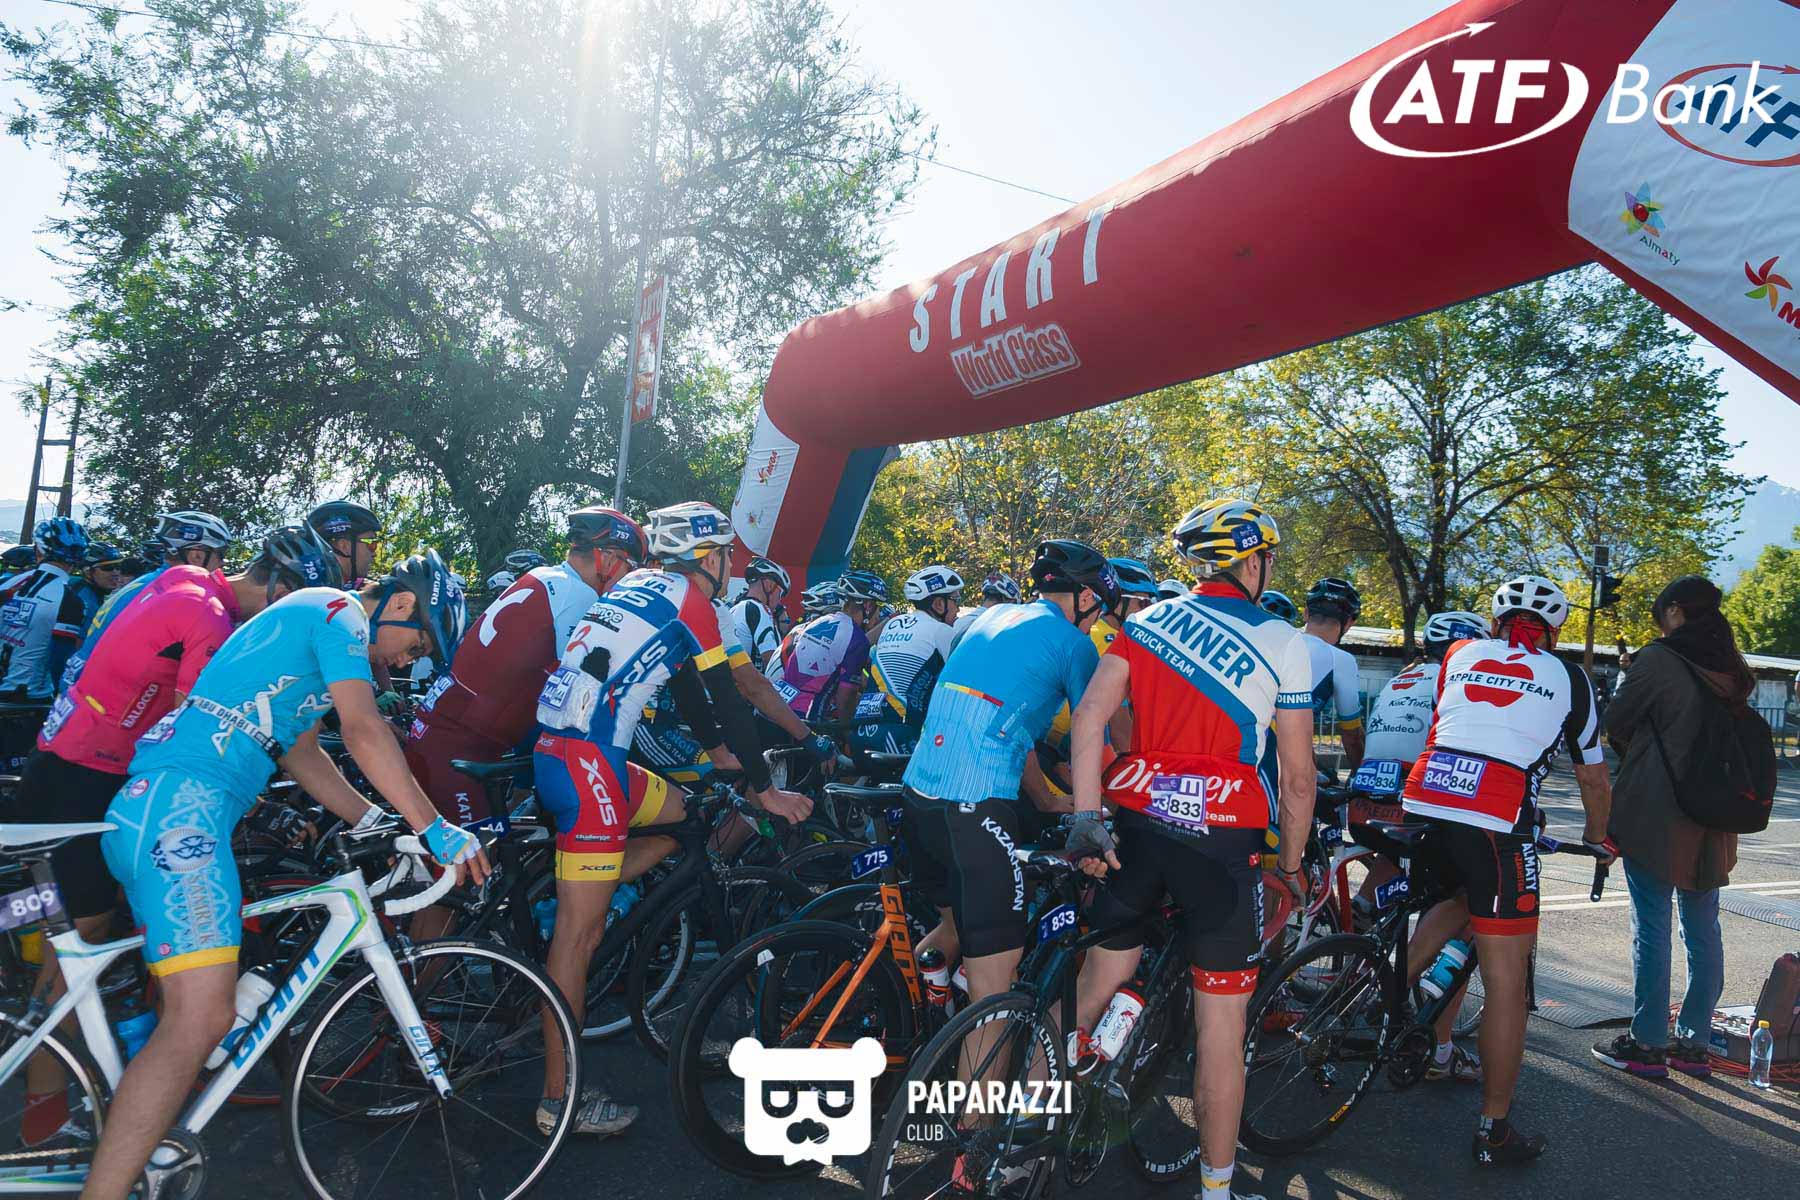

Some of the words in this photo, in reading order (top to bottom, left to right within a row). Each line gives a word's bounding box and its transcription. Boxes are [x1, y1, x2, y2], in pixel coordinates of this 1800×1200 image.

[1639, 235, 1680, 266] Almaty
[909, 200, 1116, 353] START
[955, 336, 1016, 393] World
[1008, 326, 1070, 378] Class
[615, 530, 630, 540] 757
[697, 526, 713, 535] 144
[1242, 536, 1258, 549] 833
[303, 561, 319, 580] 750
[1103, 574, 1116, 590] 775
[1130, 626, 1164, 653] TRUCK
[1165, 646, 1197, 678] TEAM
[1144, 602, 1256, 690] DINNER
[1449, 673, 1484, 682] APPLE
[1486, 676, 1516, 688] CITY
[1519, 681, 1555, 701] TEAM
[121, 683, 159, 728] BALOCCO
[1277, 692, 1313, 705] DINNER
[199, 700, 216, 713] ABU
[216, 708, 251, 731] DHABI
[1383, 724, 1415, 734] Medeo
[1108, 757, 1244, 804] Dier
[1356, 774, 1377, 786] 836
[1376, 776, 1395, 789] 836
[1425, 770, 1450, 786] 846
[1449, 775, 1476, 792] 846
[1169, 798, 1201, 818] 833
[1205, 811, 1237, 823] team
[864, 849, 889, 866] 775
[981, 816, 1025, 911] KAZAKHSTAN
[1521, 842, 1537, 891] ALMATY
[1387, 880, 1409, 896] 846
[10, 889, 54, 918] 809
[1051, 911, 1075, 931] 833
